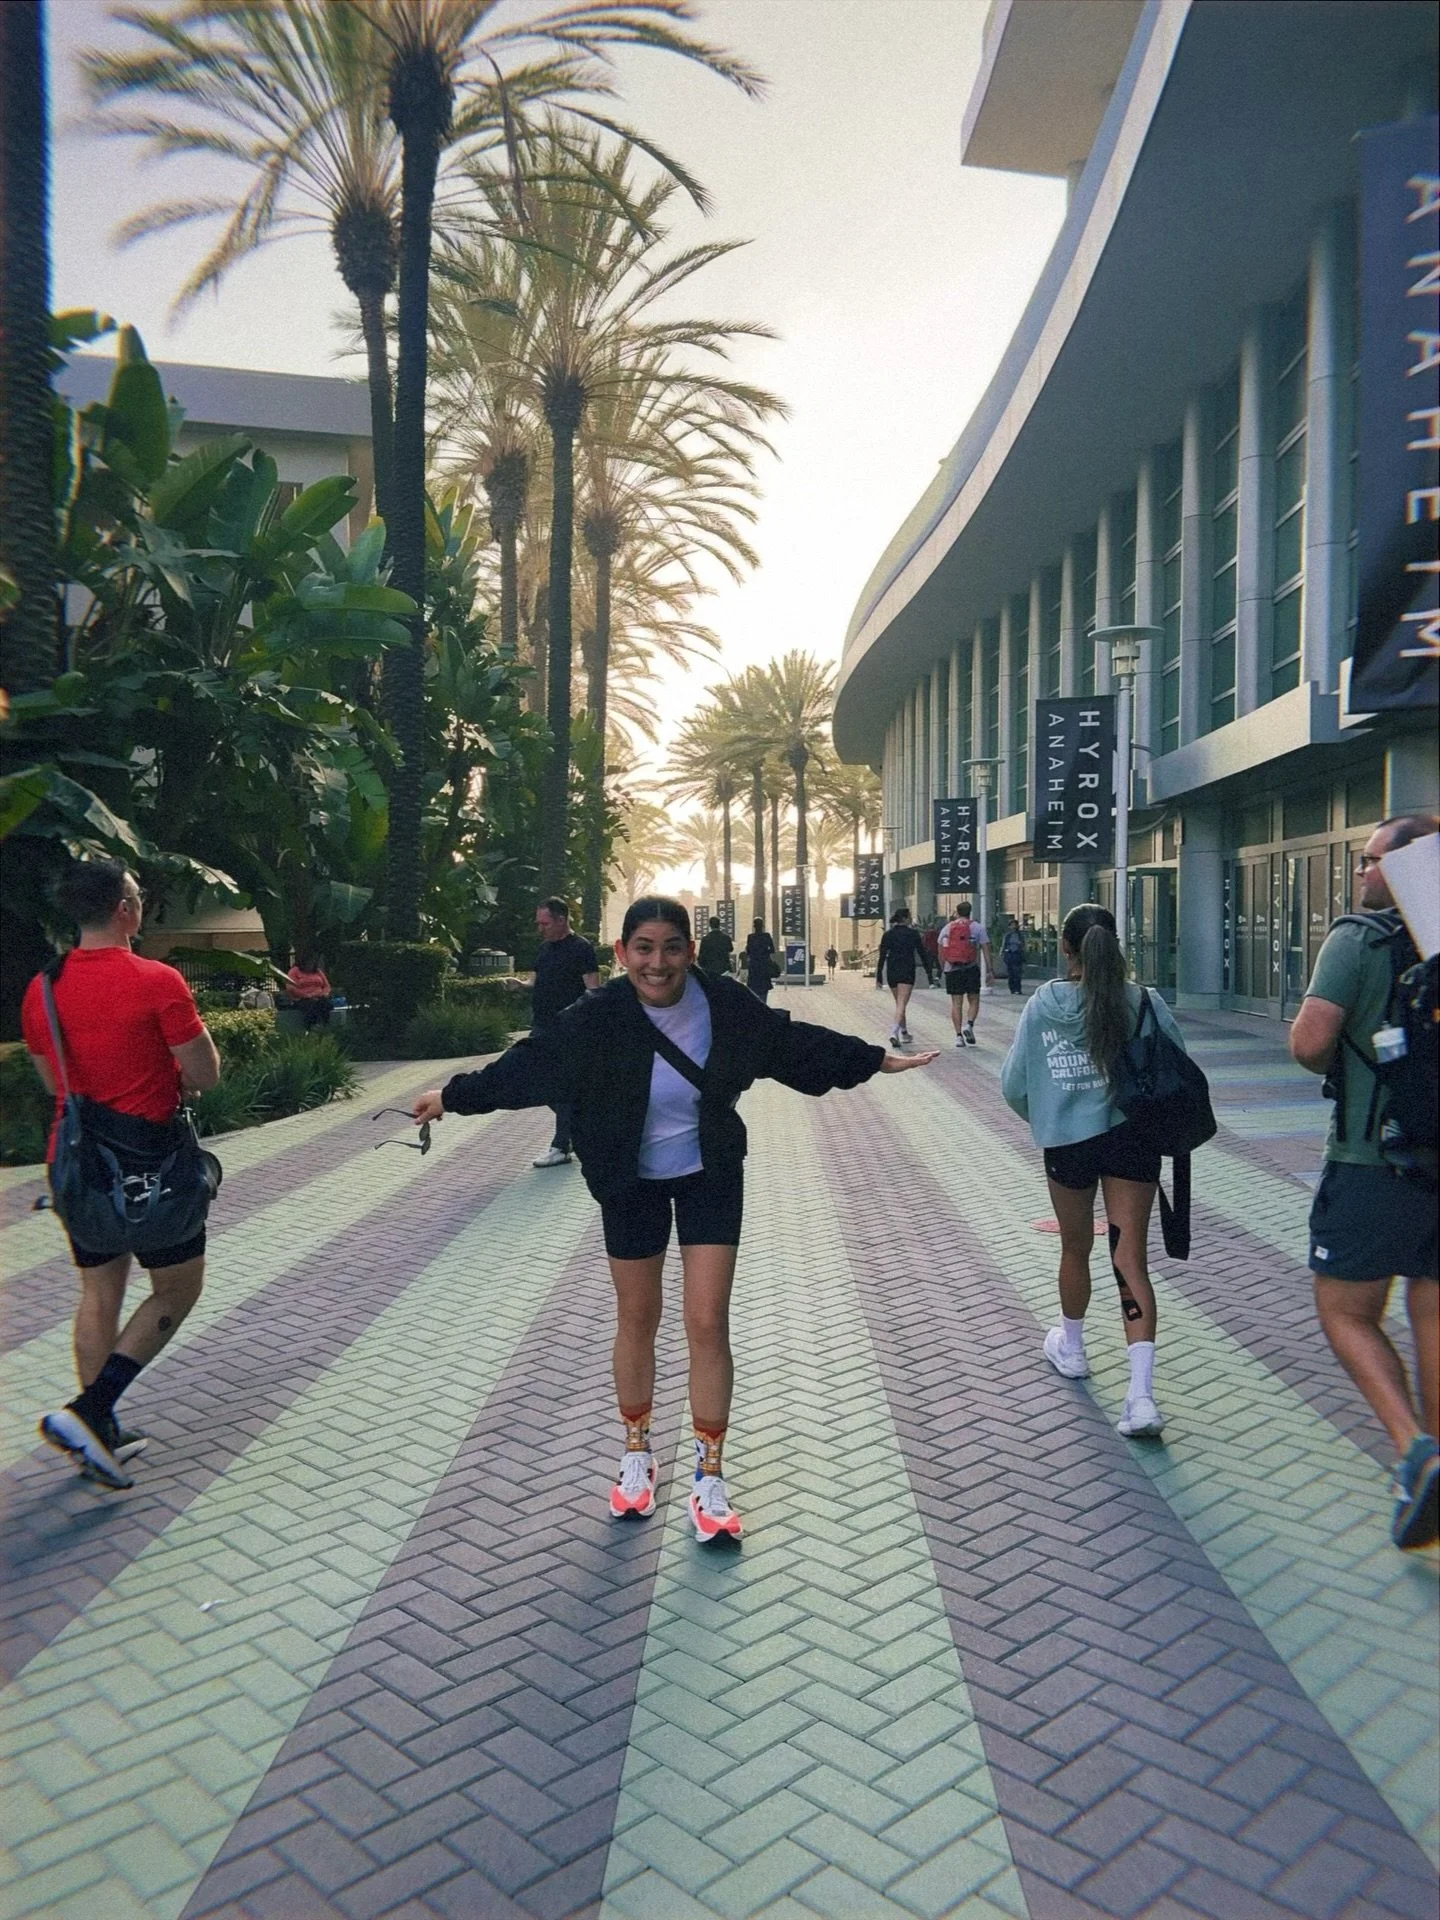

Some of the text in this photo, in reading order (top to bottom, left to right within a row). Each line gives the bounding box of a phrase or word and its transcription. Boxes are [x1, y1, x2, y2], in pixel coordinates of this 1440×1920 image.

[1047, 713, 1065, 849] ANAHEIM
[1076, 710, 1101, 849] HYROX
[940, 807, 951, 886] ANAHEIM
[957, 806, 971, 885] HYROX
[784, 889, 793, 933] HYROX
[869, 858, 879, 914] HYROX
[1272, 873, 1280, 972] HYROX
[1051, 1065, 1098, 1079] CALIFOR
